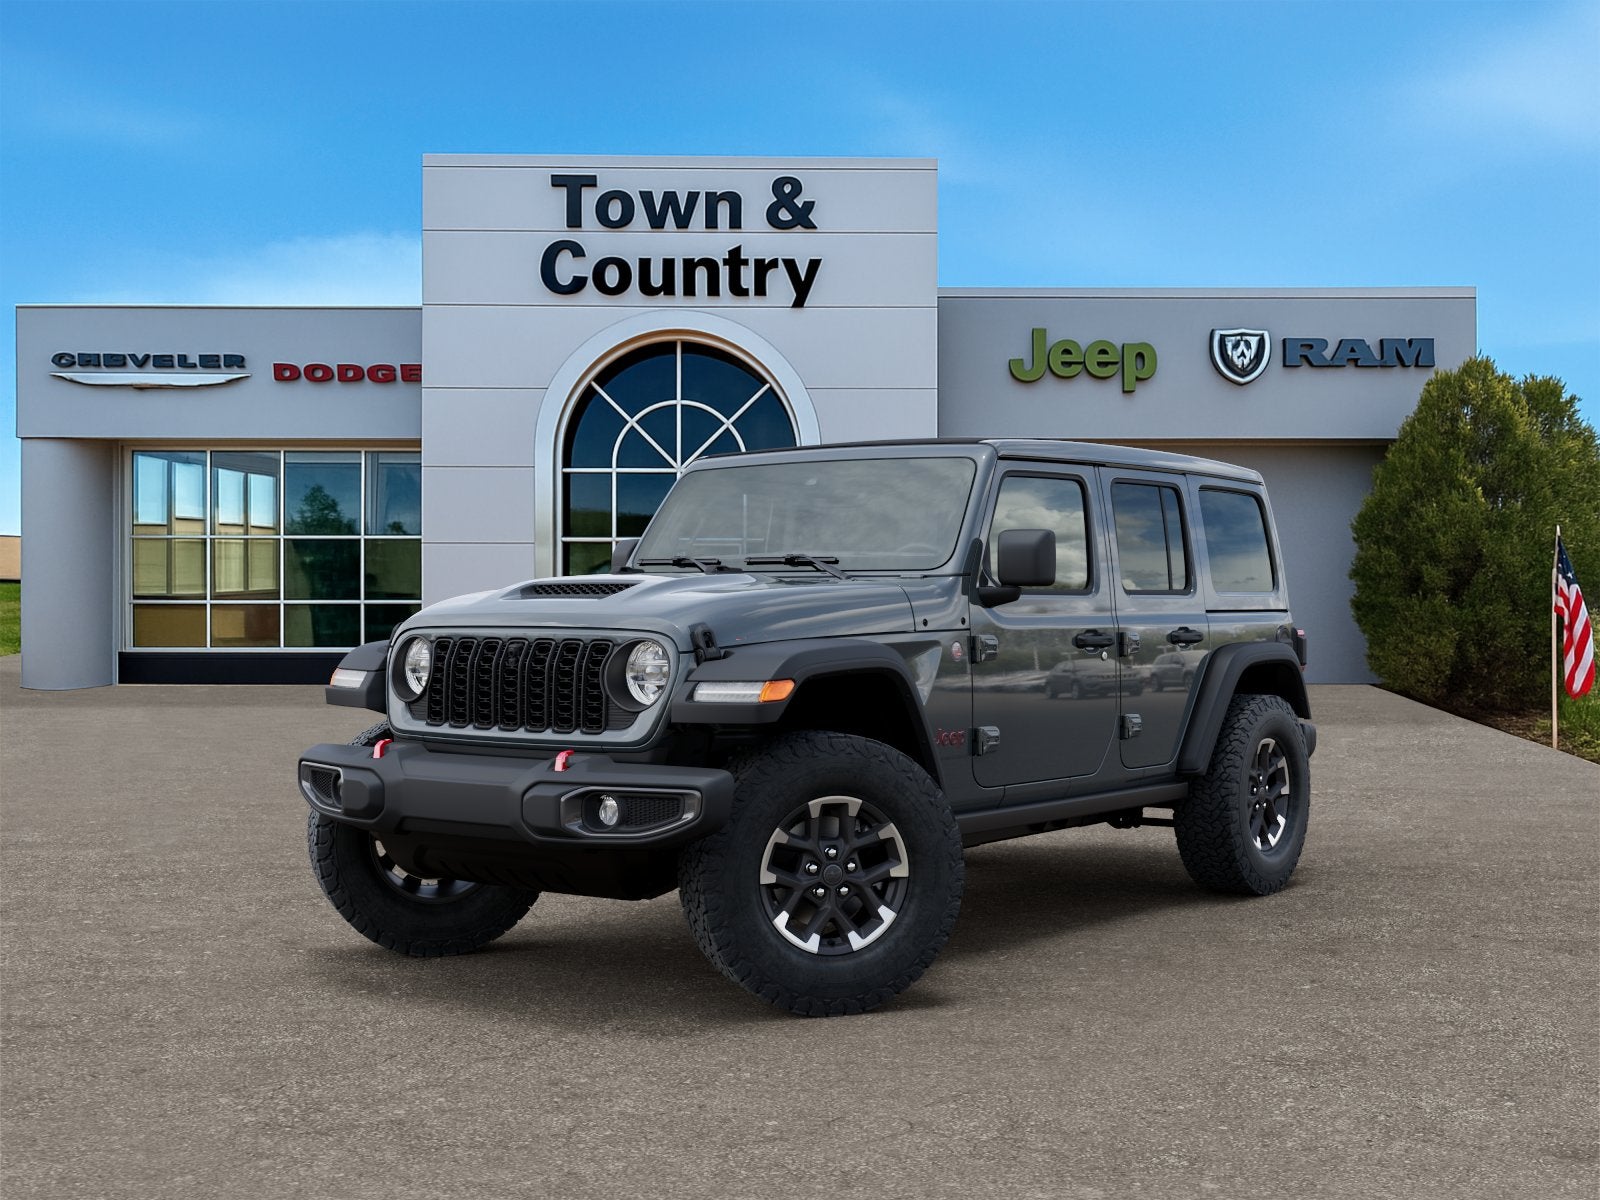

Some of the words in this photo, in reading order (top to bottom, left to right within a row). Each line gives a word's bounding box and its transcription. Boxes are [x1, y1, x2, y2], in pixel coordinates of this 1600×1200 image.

[550, 174, 742, 229] Town
[765, 176, 818, 230] &
[540, 239, 823, 308] Country
[272, 363, 422, 383] DODGE
[1008, 327, 1158, 393] Jeep
[1282, 337, 1436, 368] RAM
